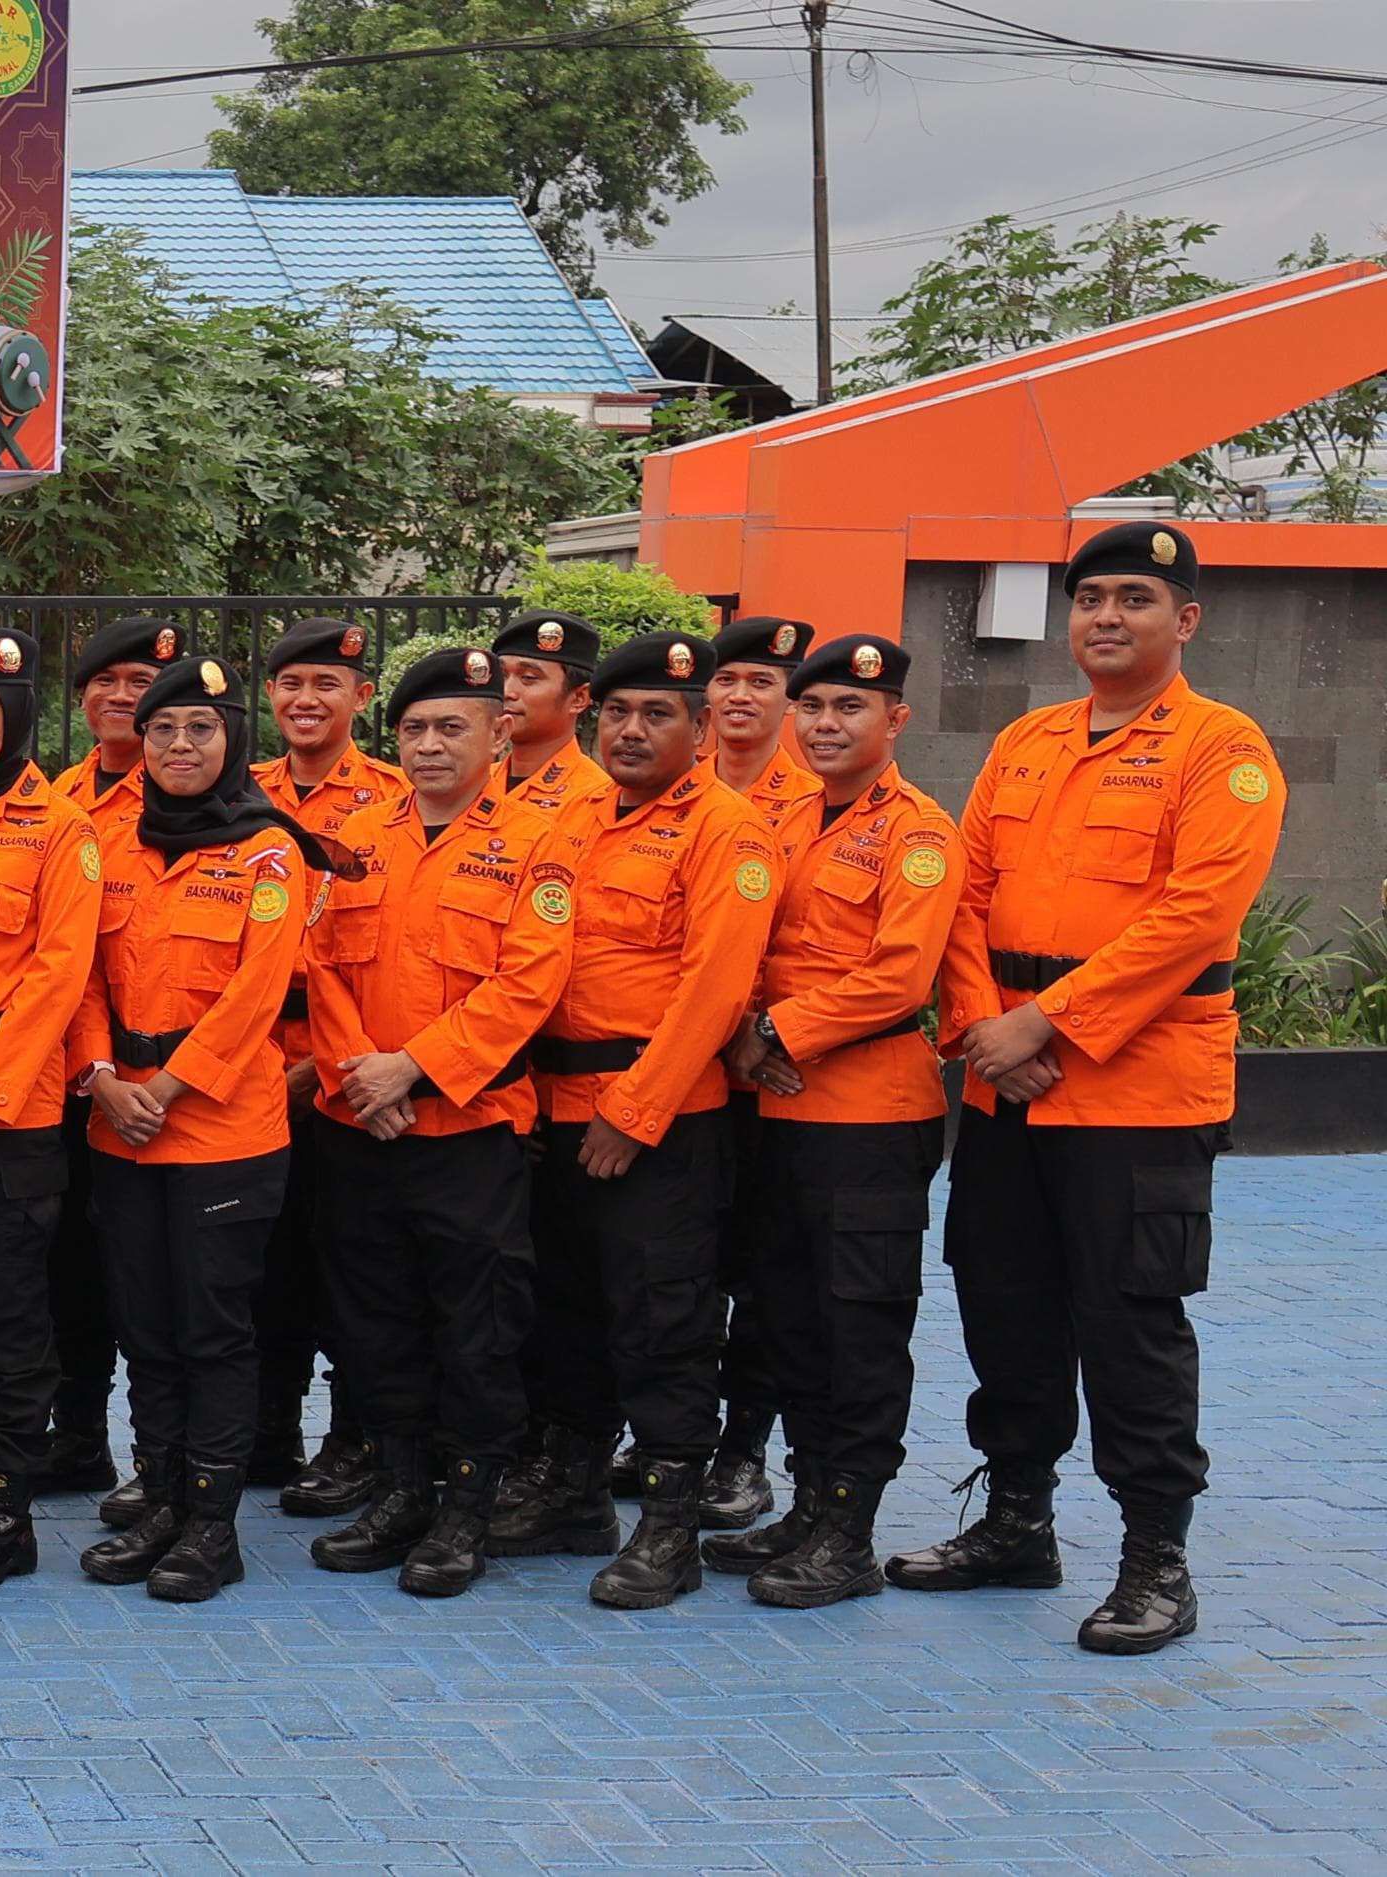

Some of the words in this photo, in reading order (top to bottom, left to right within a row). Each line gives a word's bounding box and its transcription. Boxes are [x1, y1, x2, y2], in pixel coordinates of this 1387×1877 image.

[1102, 776, 1163, 790] BASARNAS
[628, 844, 674, 860] BASARNAS
[833, 847, 880, 872] BASARNAS
[457, 862, 517, 886] BASARNAS
[185, 886, 245, 905] BASARNAS
